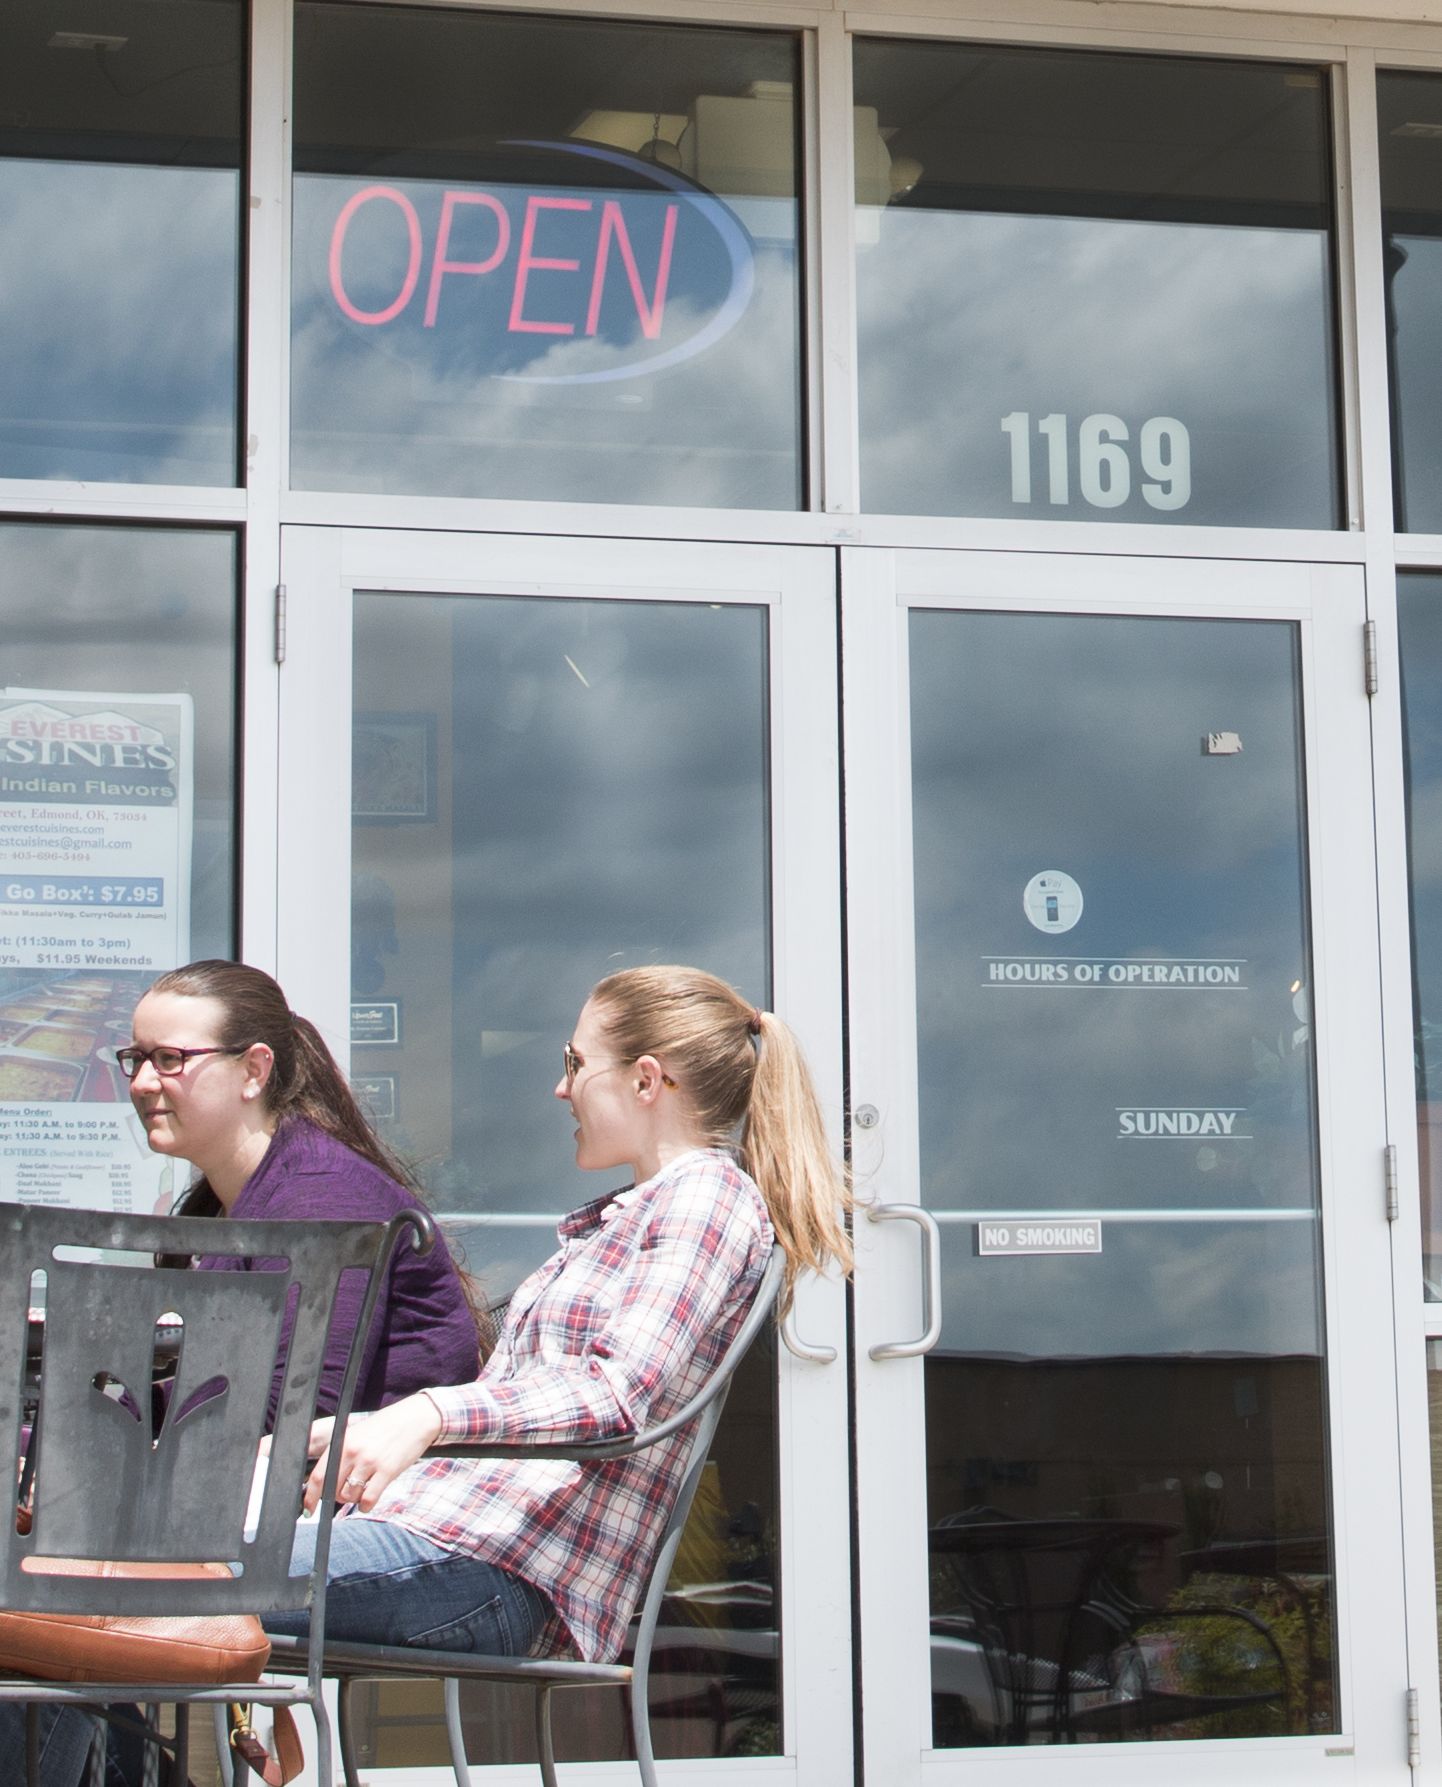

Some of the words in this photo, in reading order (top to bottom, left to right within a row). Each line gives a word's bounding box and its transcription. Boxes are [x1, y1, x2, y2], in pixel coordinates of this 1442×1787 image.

[328, 185, 680, 340] OPEN
[1000, 410, 1192, 512] 1169
[10, 720, 142, 742] EVEREST
[2, 777, 76, 794] Indian
[85, 780, 175, 798] Flavors
[31, 808, 83, 821] Edmond,
[86, 809, 109, 822] OK,
[6, 883, 35, 900] Go
[100, 884, 159, 904] $7.95
[1047, 878, 1063, 889] Pay
[16, 936, 77, 948] (11:30am
[81, 938, 94, 947] to
[98, 937, 131, 950] 3pm)
[36, 953, 81, 964] $11.95
[85, 954, 153, 966] Weekends
[989, 962, 1068, 981] HOURS
[1073, 963, 1105, 982] OF
[1107, 963, 1239, 983] OPERATION
[1119, 1111, 1236, 1135] SUNDAY
[3, 1147, 46, 1157] ENTREES
[985, 1227, 1010, 1246] NO
[1015, 1226, 1096, 1246] SMOKING
